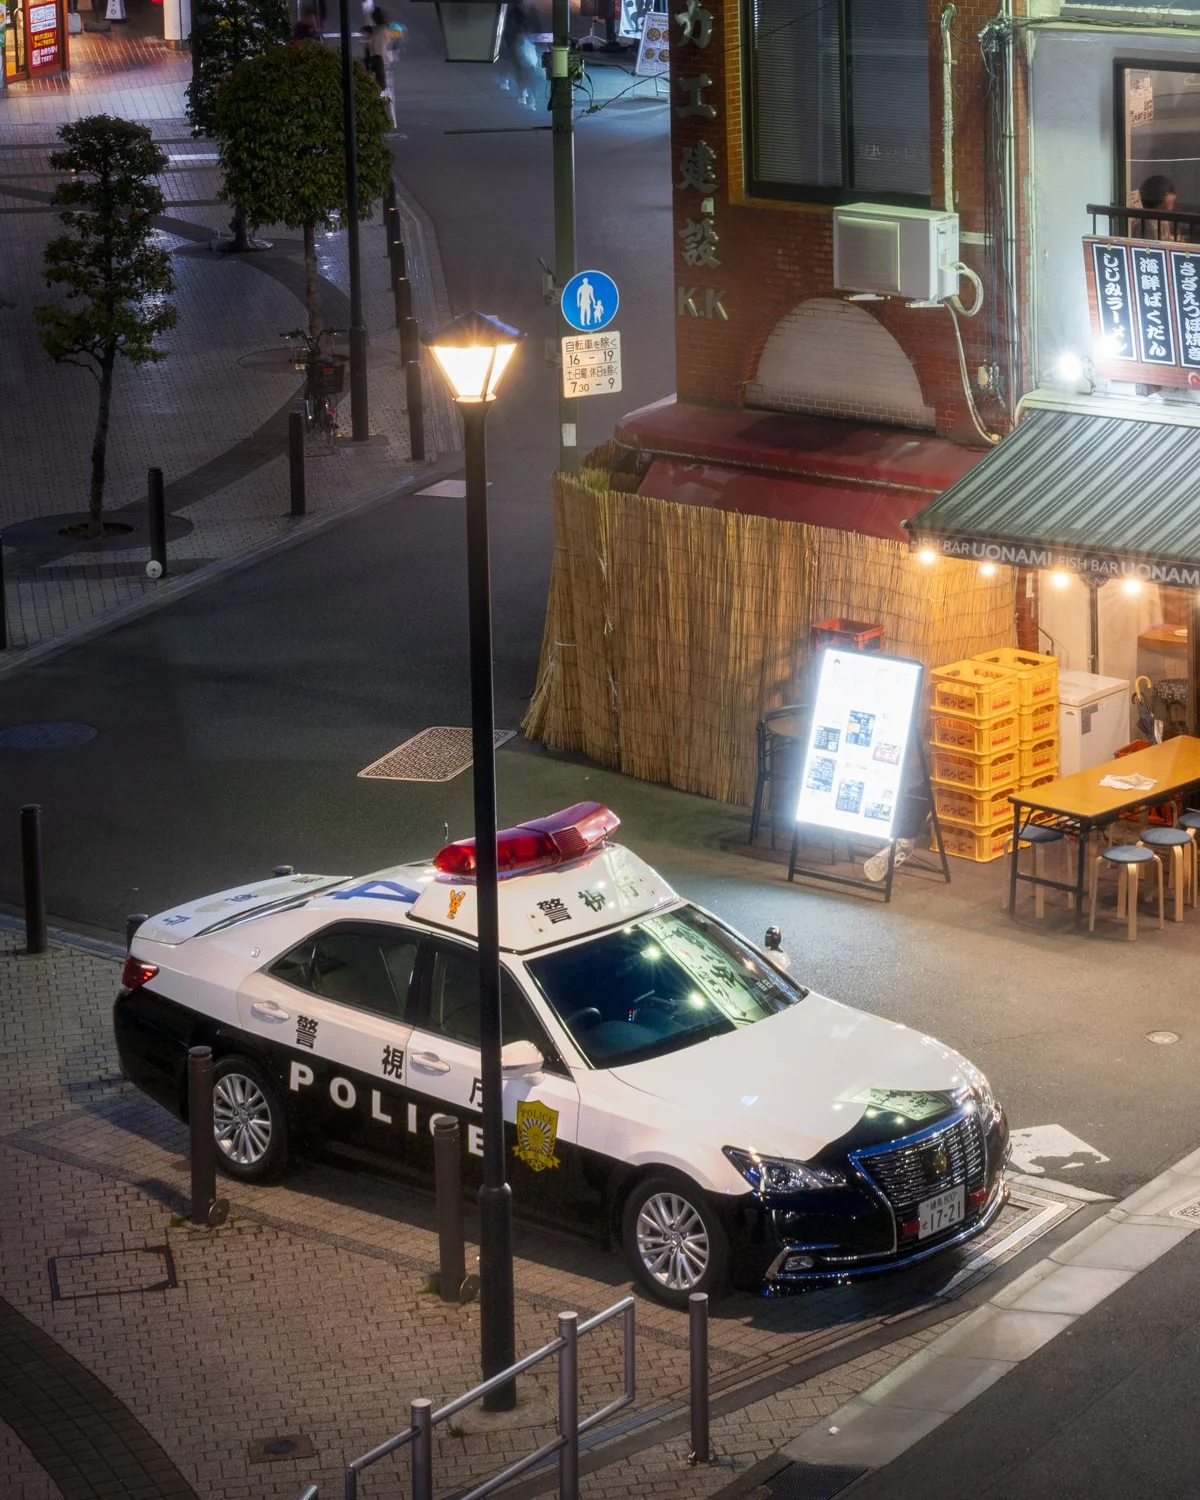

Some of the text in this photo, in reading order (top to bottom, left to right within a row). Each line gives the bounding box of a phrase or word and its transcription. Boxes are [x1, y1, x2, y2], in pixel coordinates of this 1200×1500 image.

[1139, 257, 1167, 357] 海鮮ばくだん
[565, 337, 618, 353] 自転車を除く
[569, 353, 581, 366] 16
[603, 350, 615, 363] 19
[608, 377, 616, 389] 9
[943, 540, 969, 556] BAR
[972, 542, 1053, 567] UONAMI
[1057, 555, 1087, 570] FISH
[1091, 558, 1118, 574] BAR
[941, 698, 974, 710] ホッピー
[941, 733, 974, 746] ホッピー
[941, 768, 974, 782] ホッピー
[941, 803, 974, 817] ホッピー
[930, 1200, 961, 1232] 17-21
